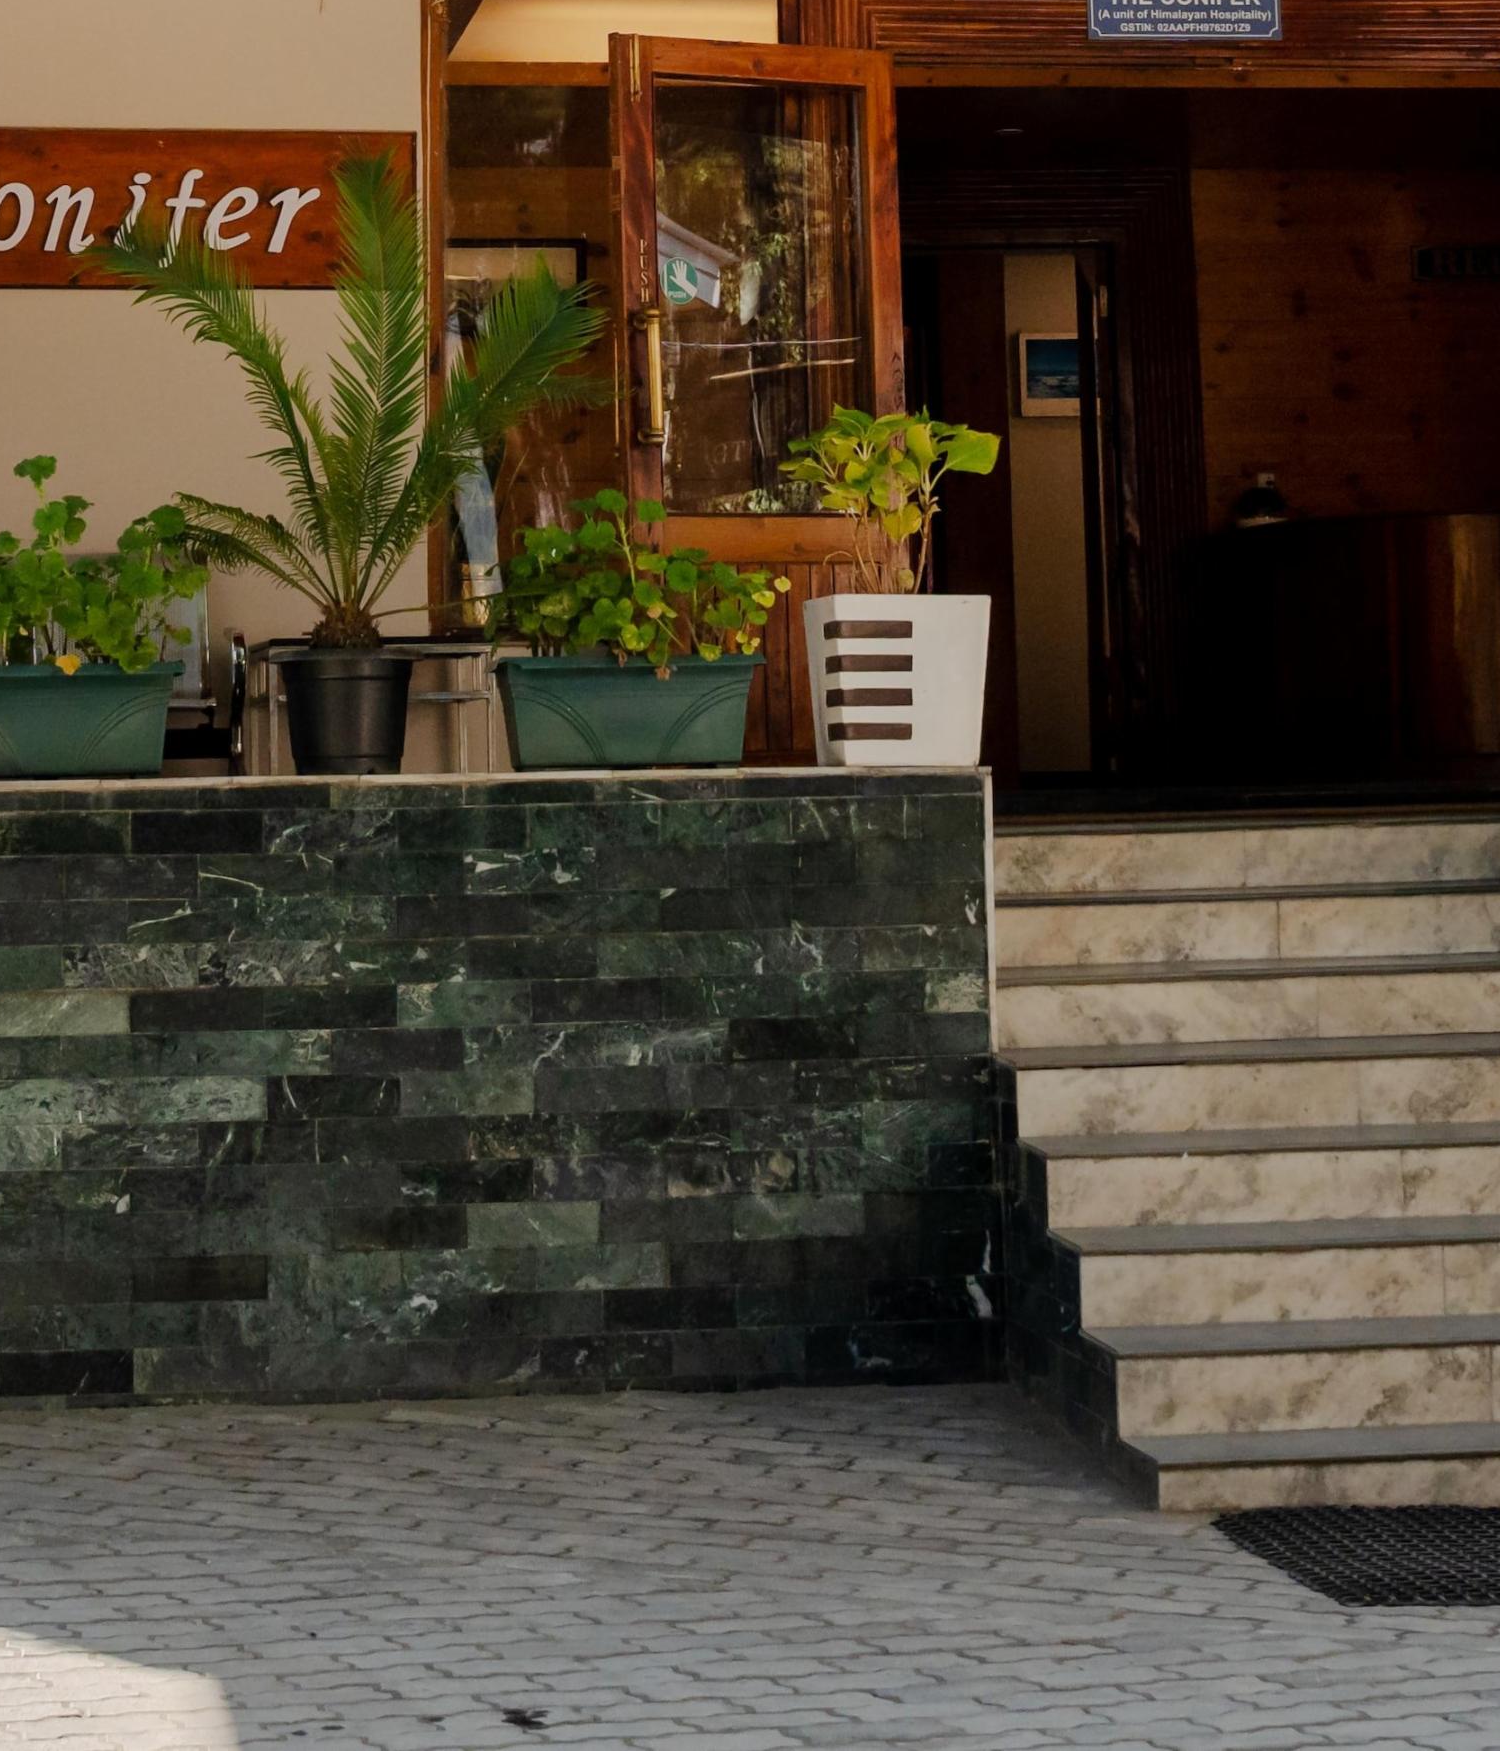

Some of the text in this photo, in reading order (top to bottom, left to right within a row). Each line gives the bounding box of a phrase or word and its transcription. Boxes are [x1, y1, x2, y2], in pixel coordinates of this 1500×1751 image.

[1098, 10, 1272, 22] (A unit of Himalayan Hospitality)
[1120, 23, 1154, 33] GSTIN:
[639, 238, 649, 303] PUSH
